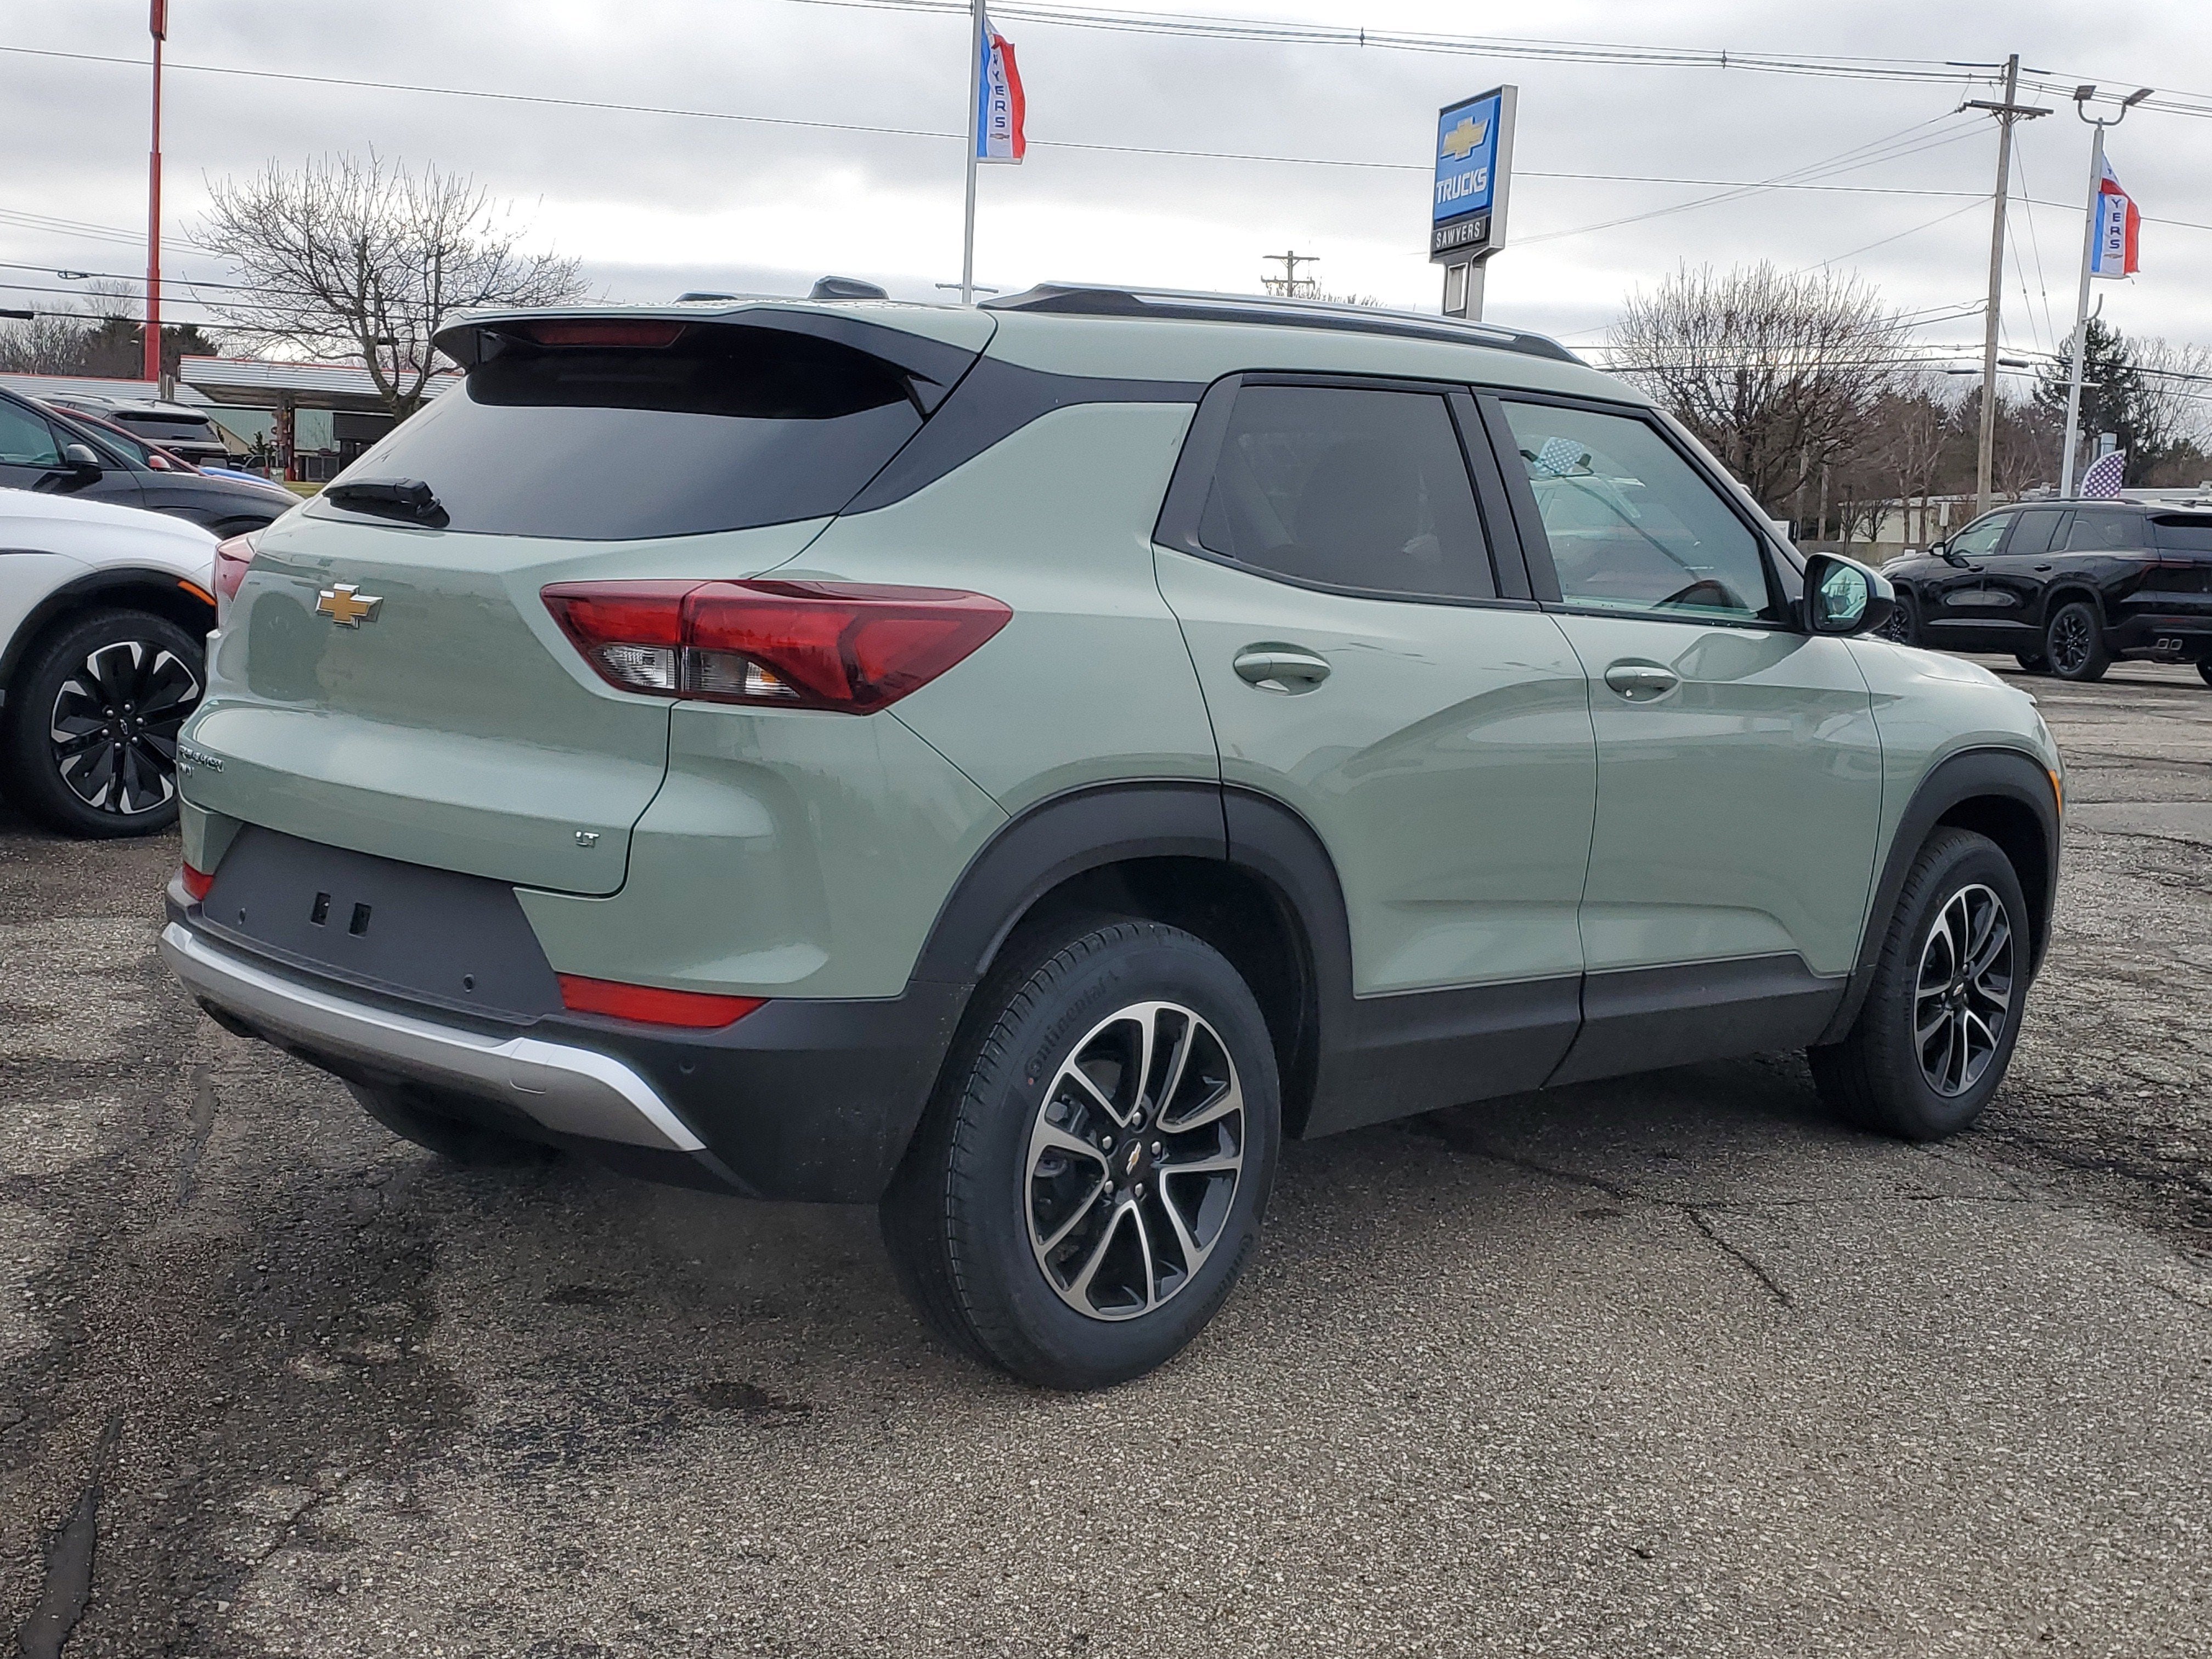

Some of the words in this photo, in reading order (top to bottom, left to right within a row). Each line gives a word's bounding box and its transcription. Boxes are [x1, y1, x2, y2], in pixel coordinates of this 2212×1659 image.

[1436, 167, 1488, 204] TRUCKS
[1436, 222, 1481, 249] SAWYERS
[2109, 199, 2122, 249] YERS
[576, 831, 600, 846] LT
